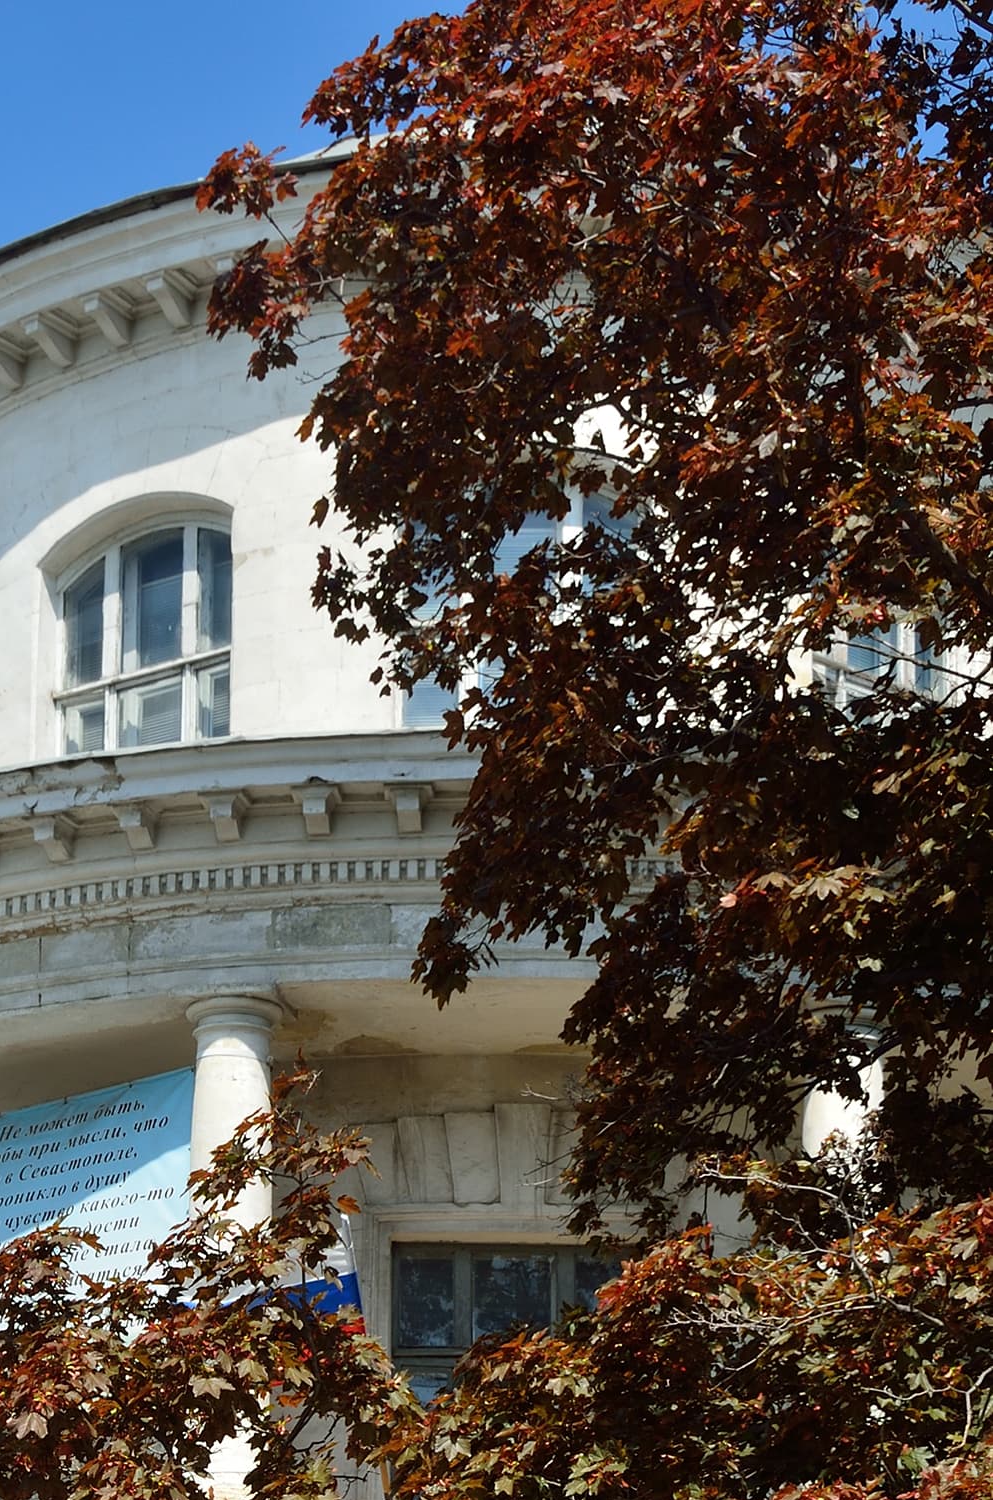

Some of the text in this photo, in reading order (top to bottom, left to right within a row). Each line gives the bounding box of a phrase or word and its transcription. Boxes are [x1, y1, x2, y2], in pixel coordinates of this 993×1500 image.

[24, 1112, 89, 1137] может
[94, 1100, 145, 1119] быть,
[29, 1141, 61, 1160] при
[64, 1127, 126, 1150] мысли,
[133, 1116, 169, 1132] что
[4, 1173, 13, 1184] в
[19, 1146, 138, 1182] Севастополе,
[71, 1182, 80, 1193] в
[84, 1170, 132, 1191] душу
[5, 1204, 74, 1228] чувство
[79, 1187, 175, 1214] какого-то
